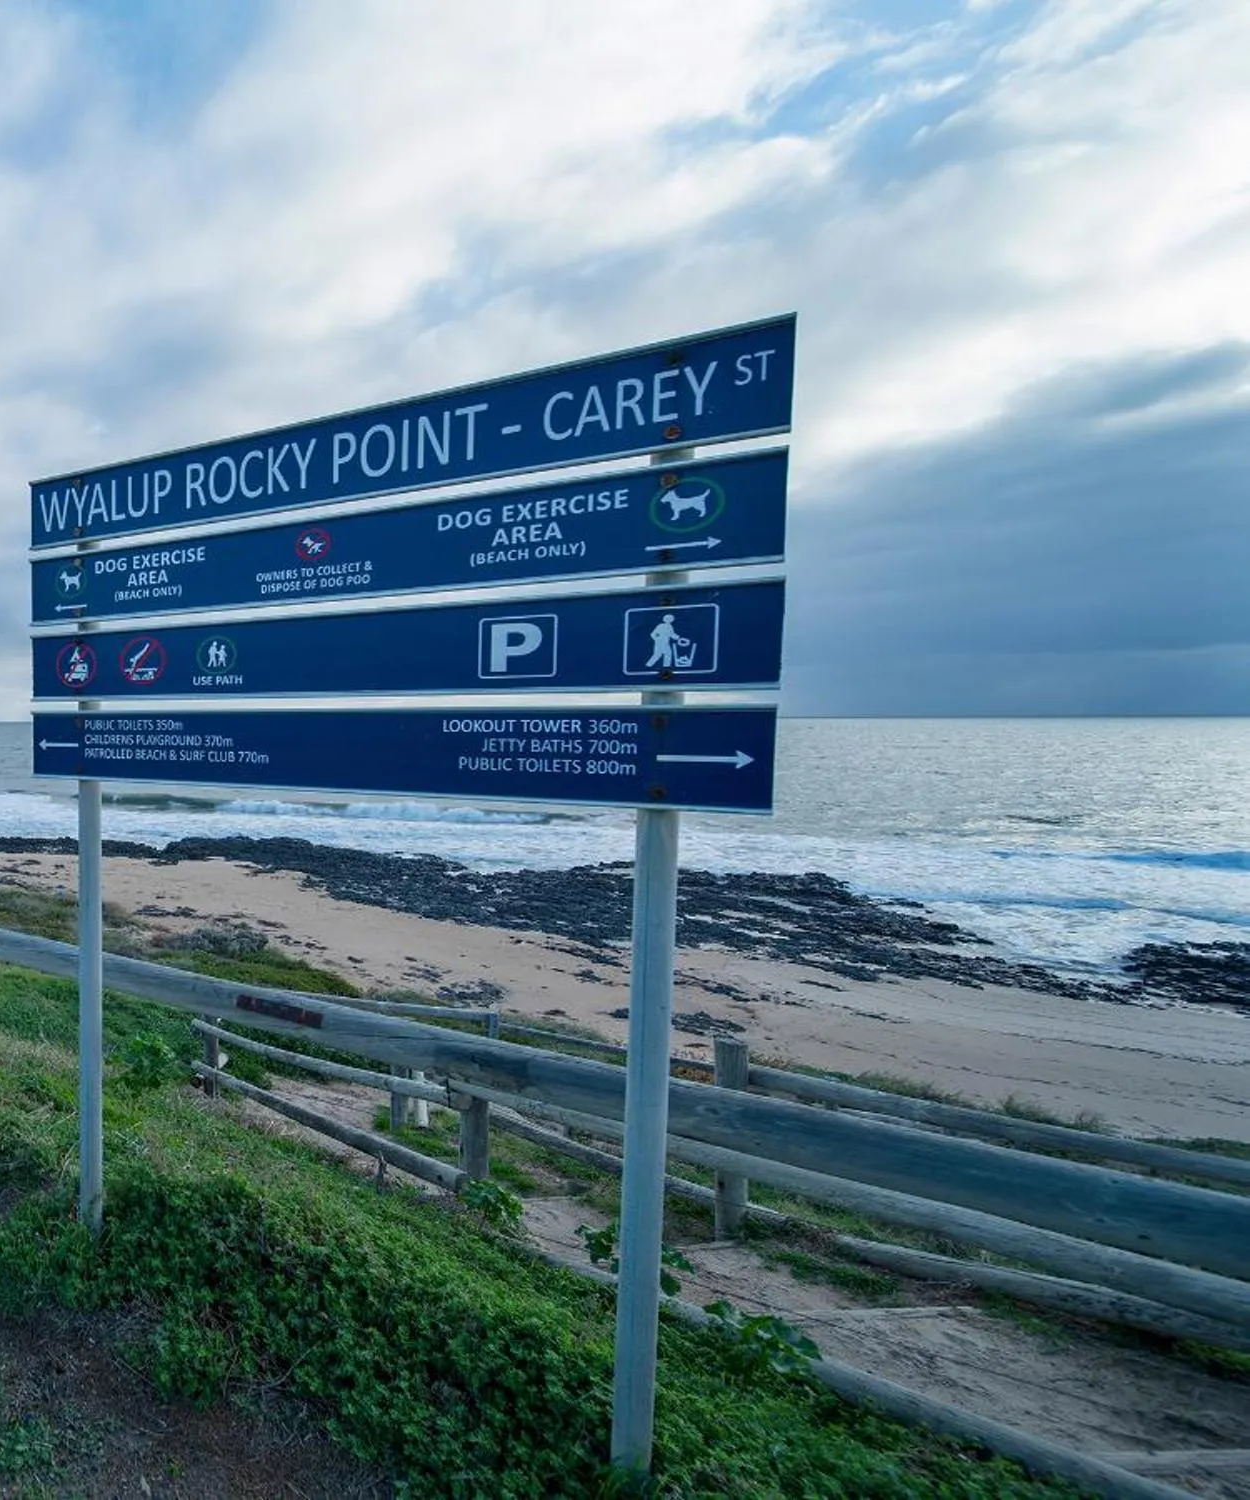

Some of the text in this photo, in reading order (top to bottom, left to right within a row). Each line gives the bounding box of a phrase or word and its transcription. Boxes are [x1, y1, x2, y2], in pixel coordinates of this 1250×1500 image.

[39, 349, 776, 533] WYALUP ROCKY POINT - CAREY ST
[437, 489, 630, 532] DOG EXERCISE
[491, 522, 563, 547] AREA
[94, 546, 206, 575] DOG EXERCISE
[469, 540, 587, 568] (BEACH ONLY)
[126, 571, 168, 587] AREA
[255, 560, 373, 583] OWNERS TO COLLECT &
[114, 584, 183, 602] (BEACH ONLY)
[260, 574, 371, 595] DISPOSE OF DOG POO
[489, 622, 543, 673] P
[192, 674, 243, 686] USE PATH
[84, 719, 184, 732] PUBLIC TOILETS 350m
[442, 719, 638, 735] LOOKOUT TOWER 360m
[84, 733, 234, 748] CHILDRENS PLAYGROUND 370m
[481, 738, 638, 756] JETTY BATHS 700m
[84, 748, 270, 765] PATROLLED BEACH & SURF CLUB 770m
[458, 756, 636, 776] PUBLIC TOILETS 800m
